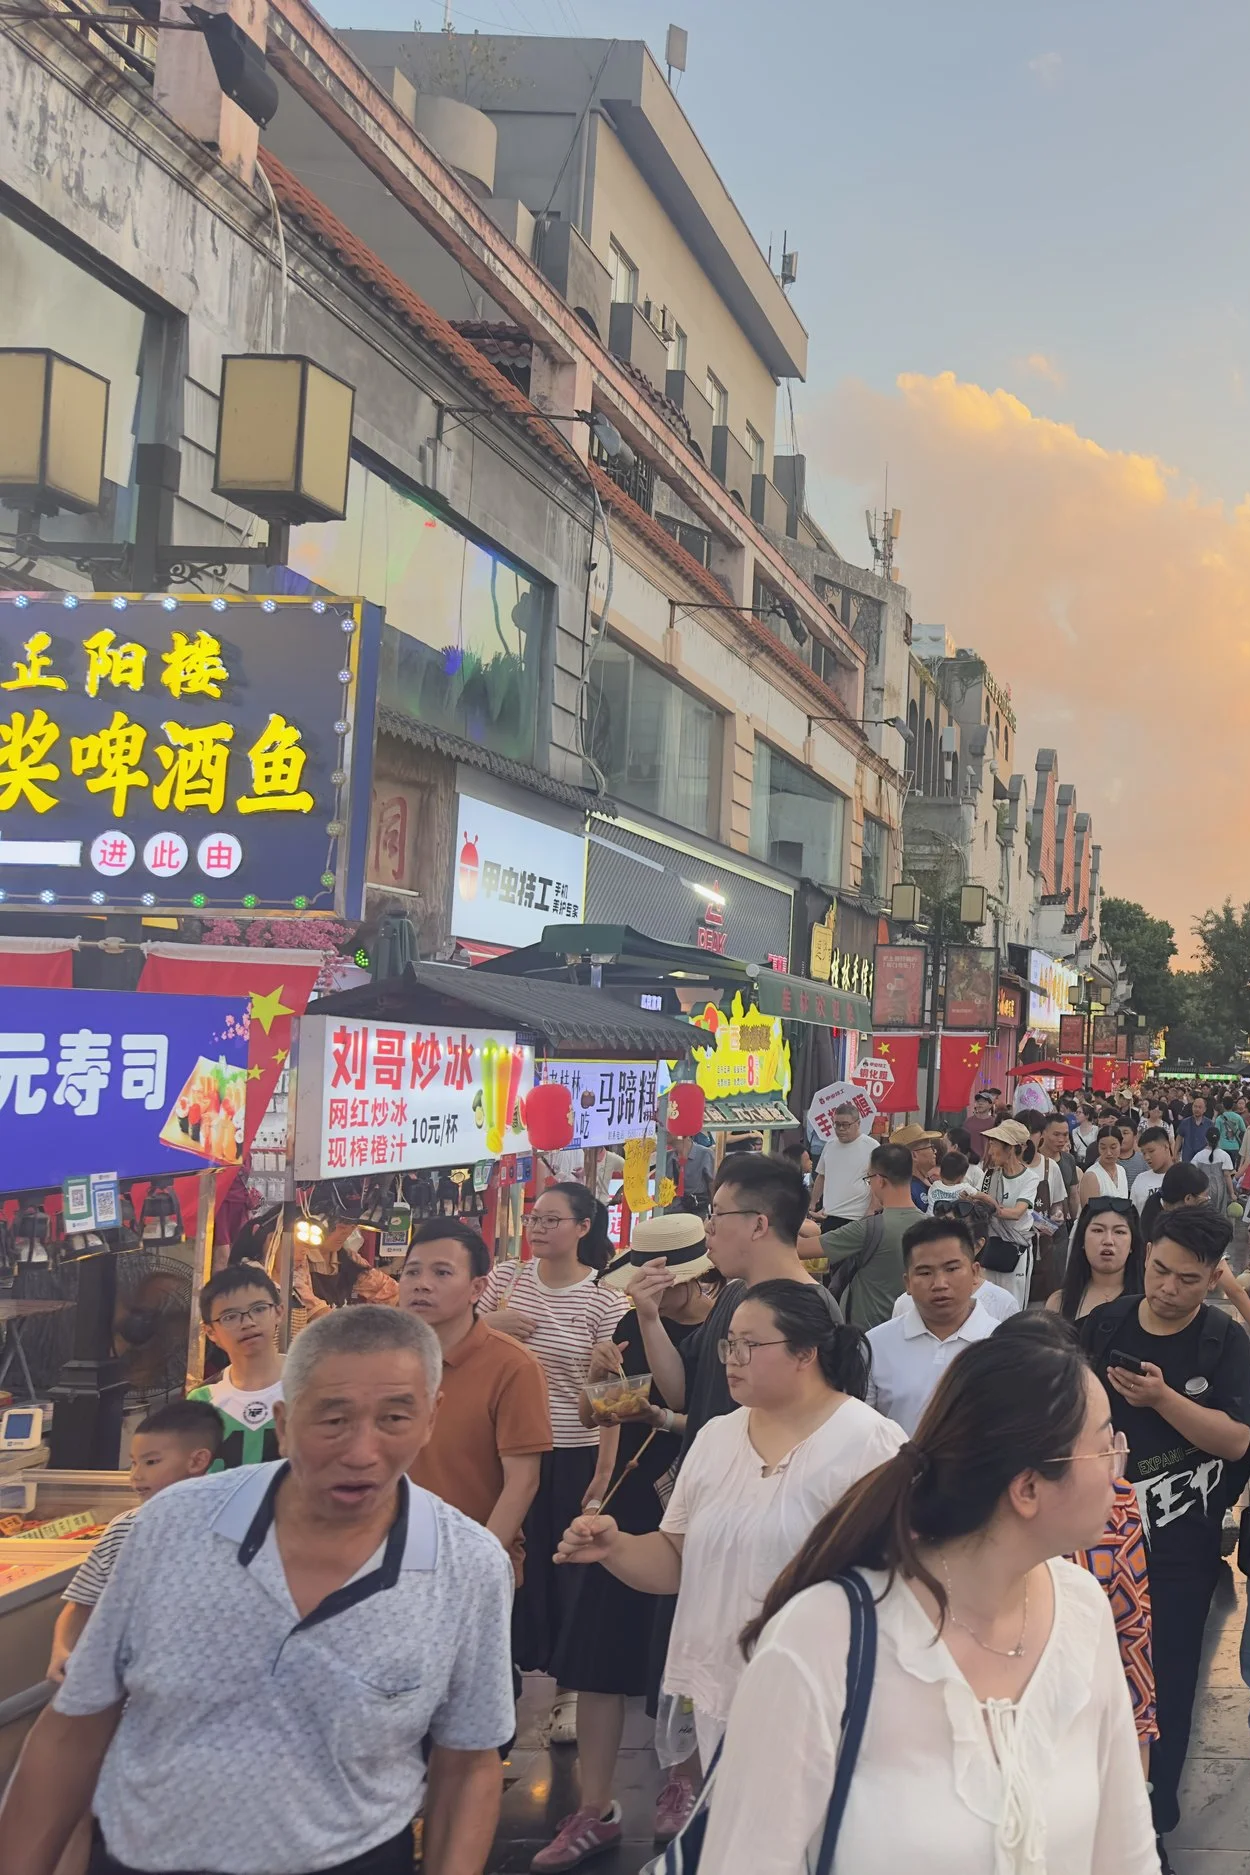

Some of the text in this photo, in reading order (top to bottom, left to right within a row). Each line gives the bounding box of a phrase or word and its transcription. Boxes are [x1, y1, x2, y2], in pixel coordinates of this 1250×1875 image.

[1, 627, 229, 699] 正阳楼
[482, 860, 553, 912] 甲虫特工
[0, 1028, 169, 1117] 元寿司
[330, 1024, 475, 1091] 刘哥炒冰
[328, 1096, 408, 1130] 网红炒冰
[596, 1070, 657, 1126] 马蹄糕
[865, 1081, 884, 1097] 10
[327, 1135, 408, 1169] 现榨橙汁
[411, 1112, 460, 1145] 10元/杯
